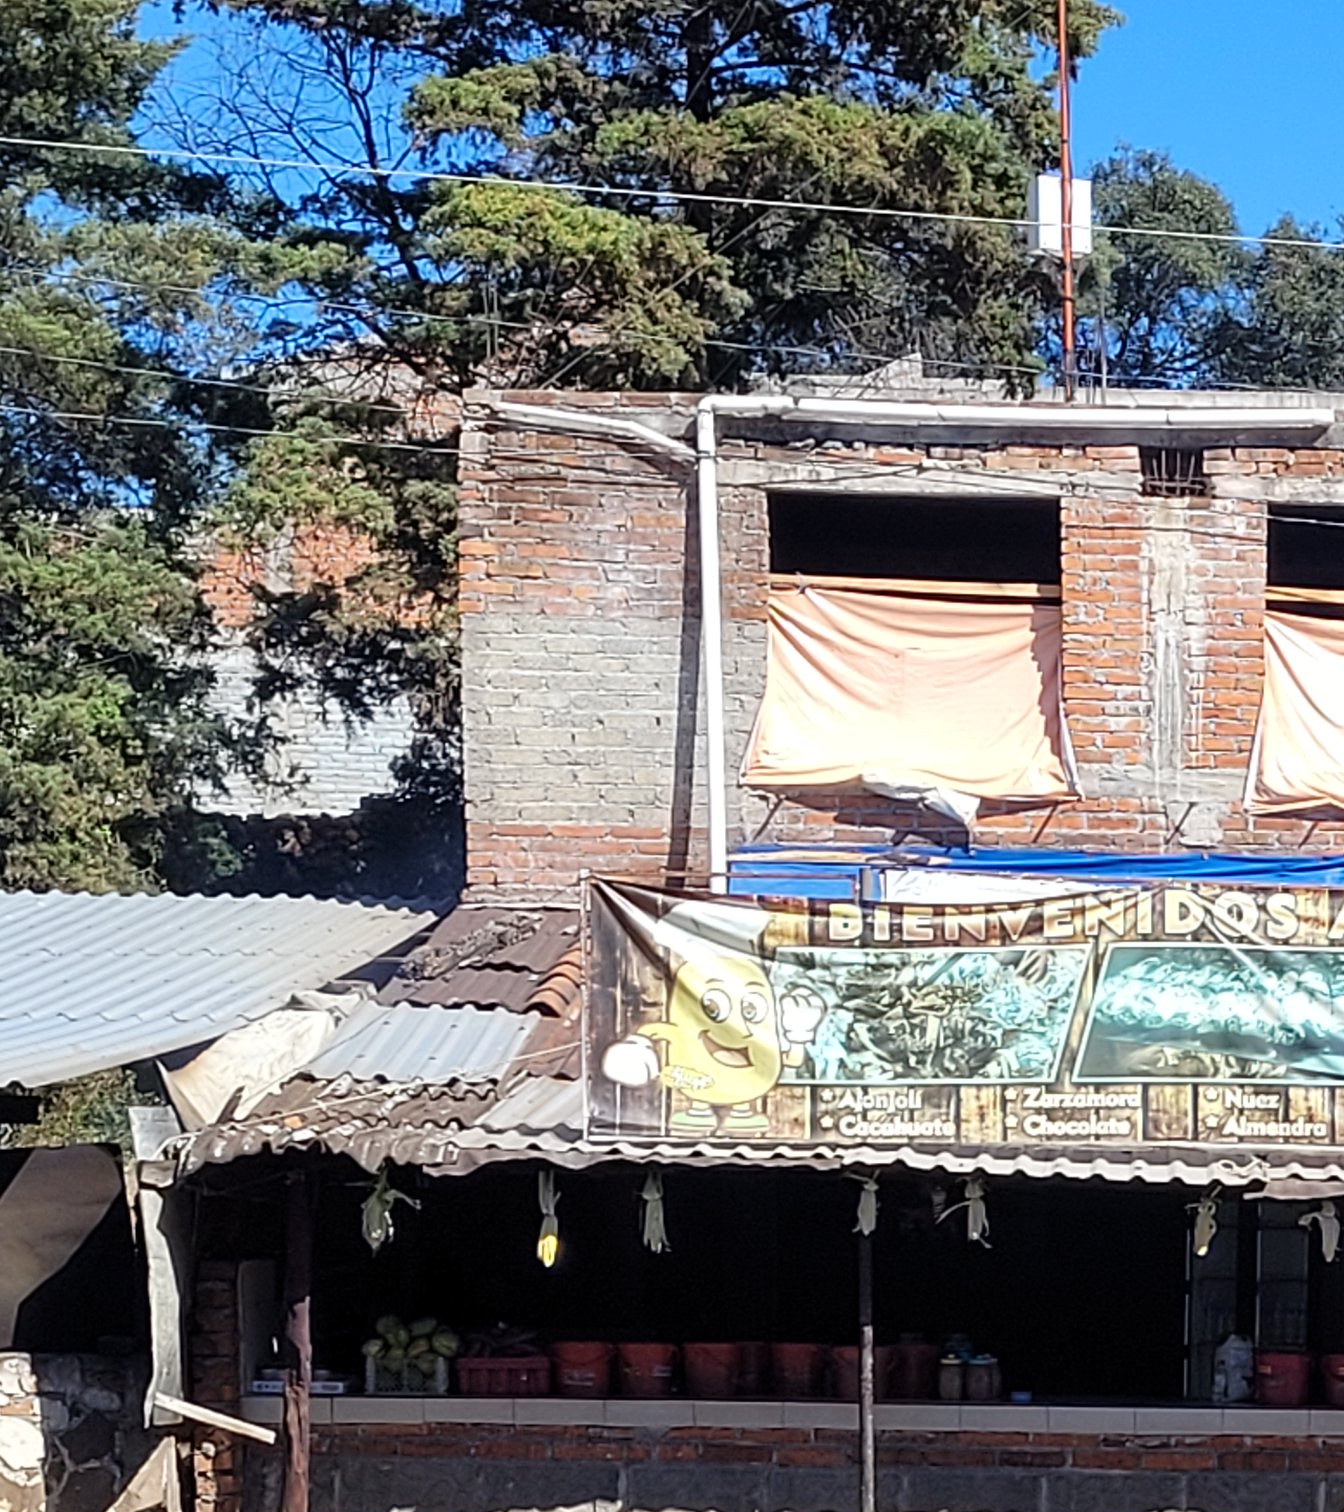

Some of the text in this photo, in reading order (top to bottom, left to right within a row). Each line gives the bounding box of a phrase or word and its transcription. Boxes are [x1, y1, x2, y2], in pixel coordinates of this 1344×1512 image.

[828, 887, 1298, 943] BIENVENIDOS
[1023, 1088, 1141, 1108] Zarzamora
[1224, 1088, 1280, 1109] Nuez
[839, 1116, 956, 1137] Cacahuate
[1023, 1115, 1131, 1135] Chocolate
[1222, 1116, 1328, 1137] Almendra
